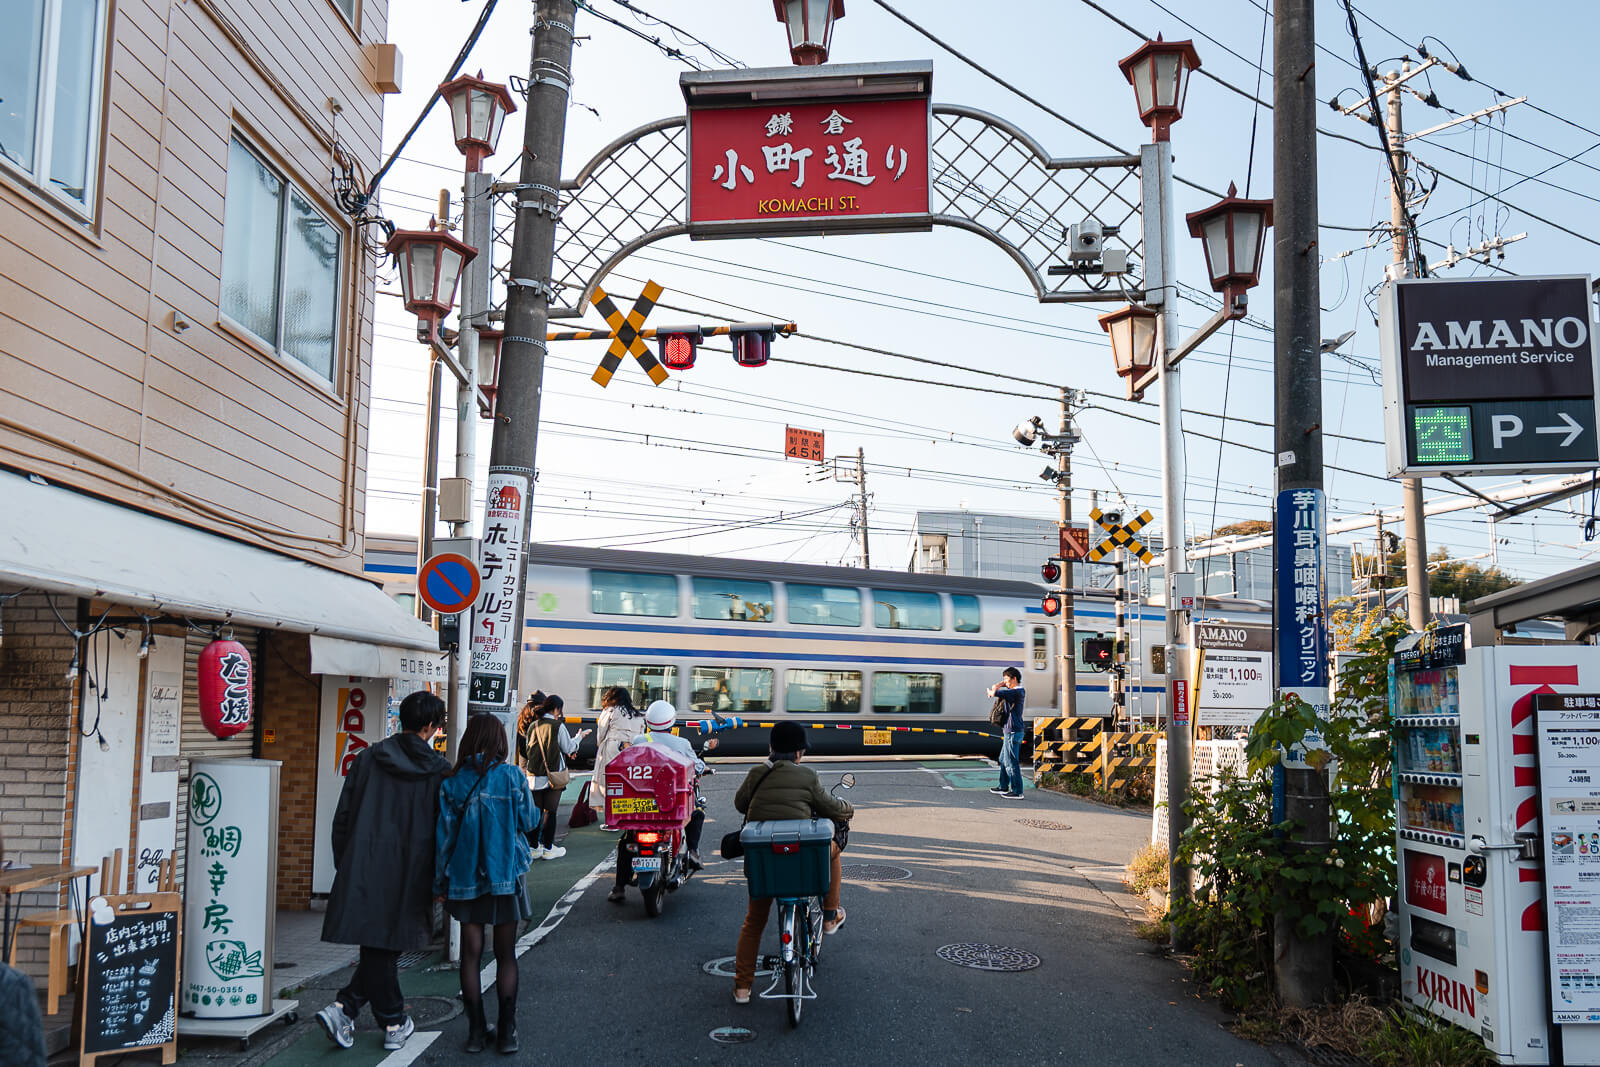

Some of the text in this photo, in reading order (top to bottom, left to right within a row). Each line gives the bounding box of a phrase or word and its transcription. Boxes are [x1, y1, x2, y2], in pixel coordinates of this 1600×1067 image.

[764, 109, 854, 138] 鎌倉
[711, 137, 908, 191] 小町通り
[757, 196, 860, 214] KOMACHI ST.
[1410, 316, 1588, 352] AMANO
[1426, 351, 1575, 369] Management Service
[1414, 408, 1470, 462] 空
[1491, 414, 1524, 449] P
[477, 522, 508, 614] ホテル
[1198, 627, 1247, 642] AMANO
[472, 652, 492, 661] 0467
[1400, 650, 1420, 660] ENERGY
[471, 661, 508, 672] 22-2230
[219, 652, 250, 725] たこ焼
[474, 678, 501, 690] 小町
[476, 690, 496, 700] 1-6
[627, 766, 653, 780] 122
[1415, 879, 1446, 900] 午後の紅茶
[105, 919, 168, 945] 店内ご利用
[1416, 965, 1476, 1019] KIRIN
